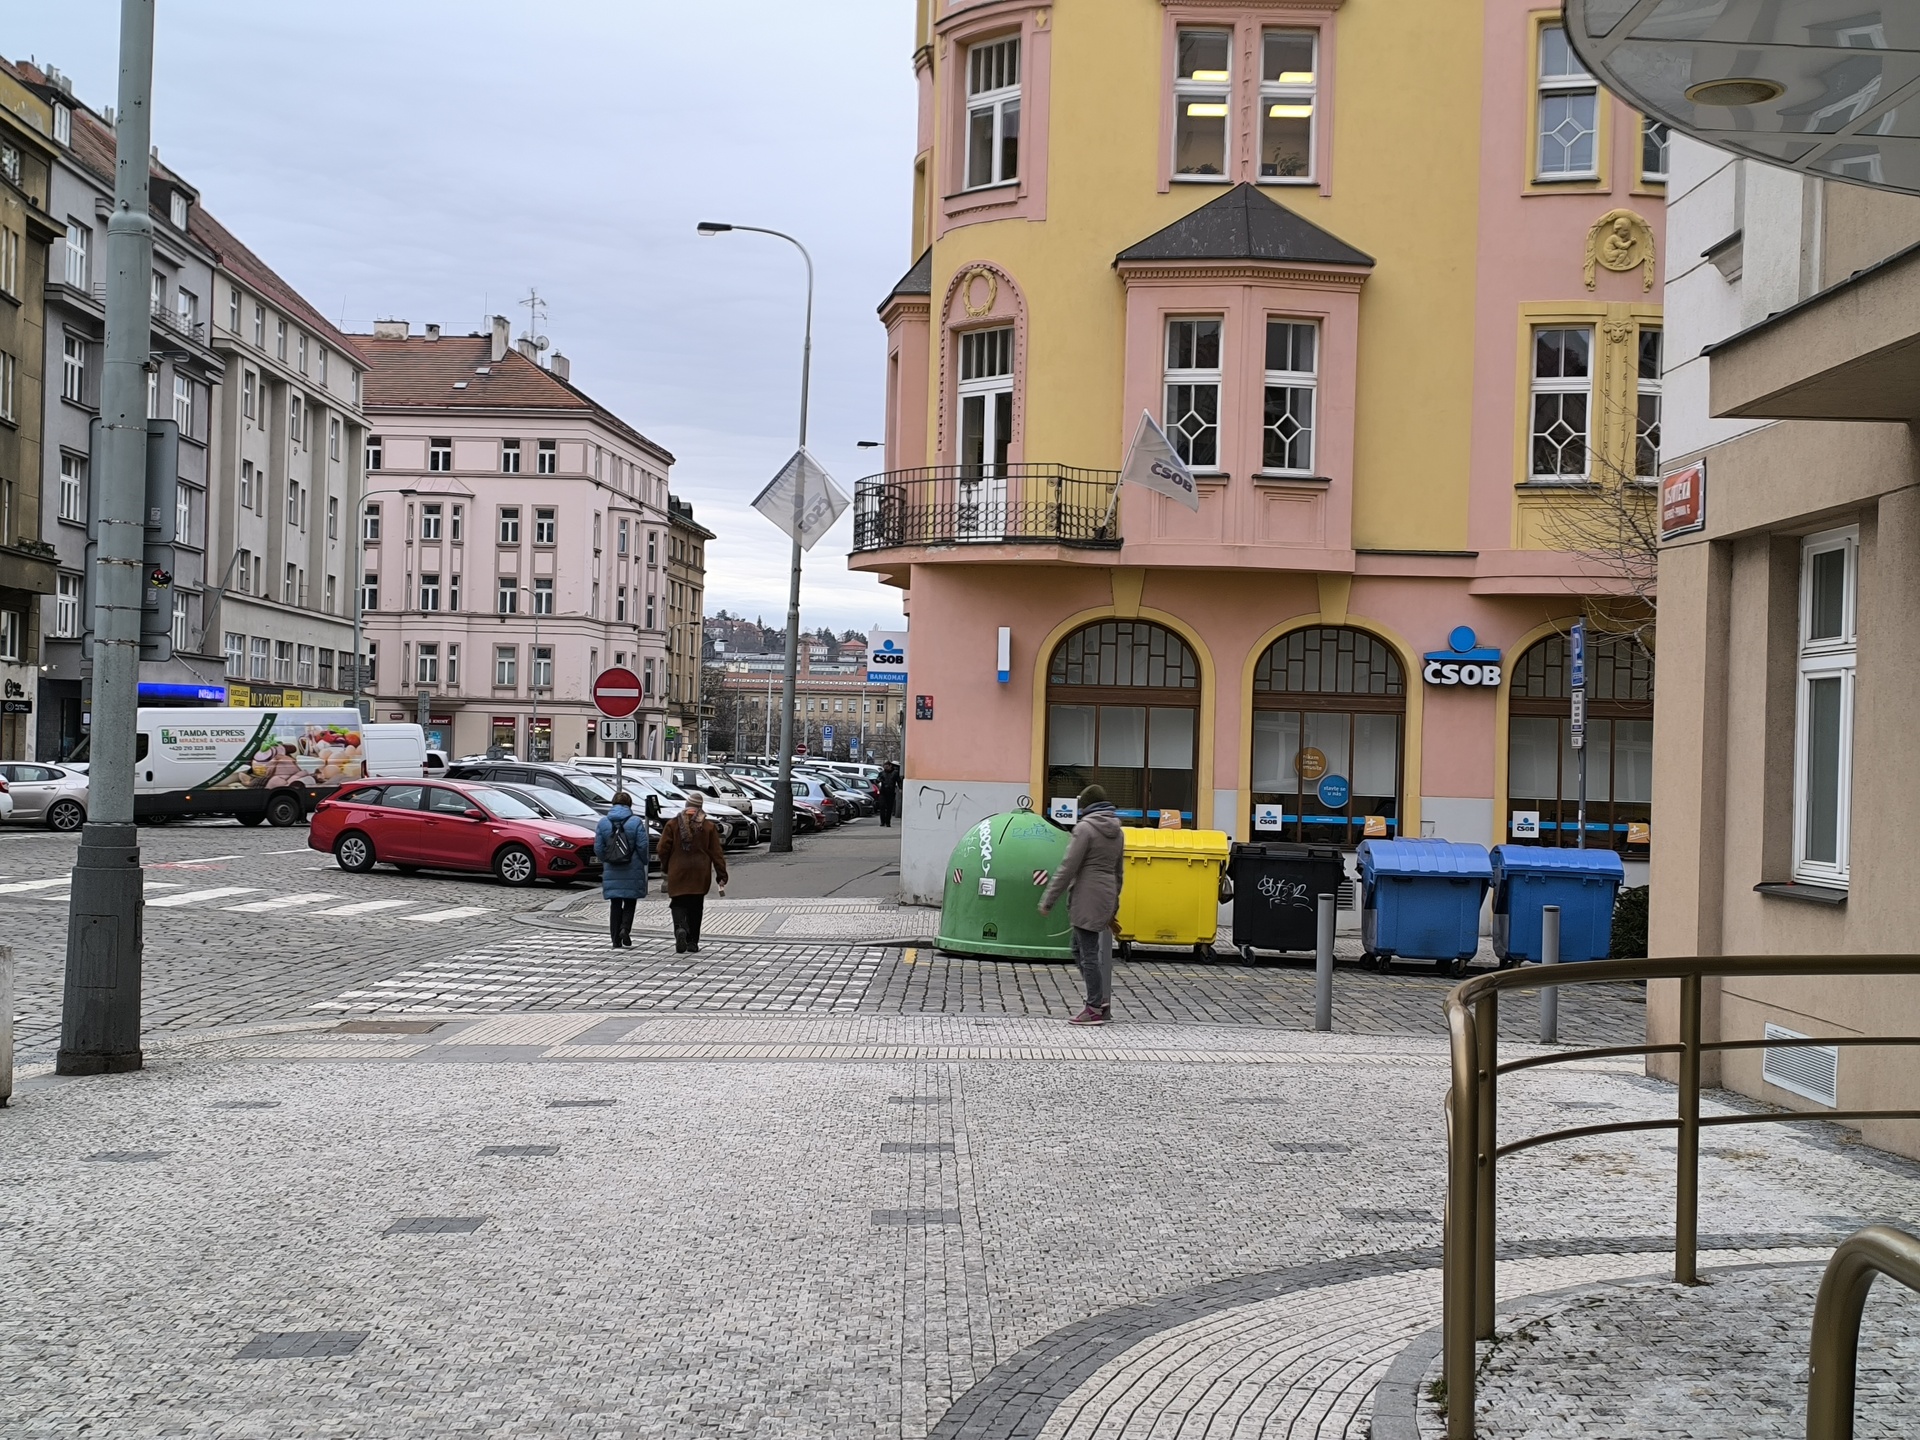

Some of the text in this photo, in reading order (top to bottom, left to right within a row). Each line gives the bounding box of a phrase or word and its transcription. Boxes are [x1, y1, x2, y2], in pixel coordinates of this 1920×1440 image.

[1150, 461, 1193, 493] ČSOB
[873, 653, 904, 664] ČSOB
[869, 673, 905, 681] BANKOMAT
[1423, 660, 1501, 686] ČSOB
[263, 693, 282, 707] COPIER
[178, 729, 246, 737] TAMDA EXPRESS
[825, 727, 831, 735] P
[1259, 817, 1278, 825] ČSOB
